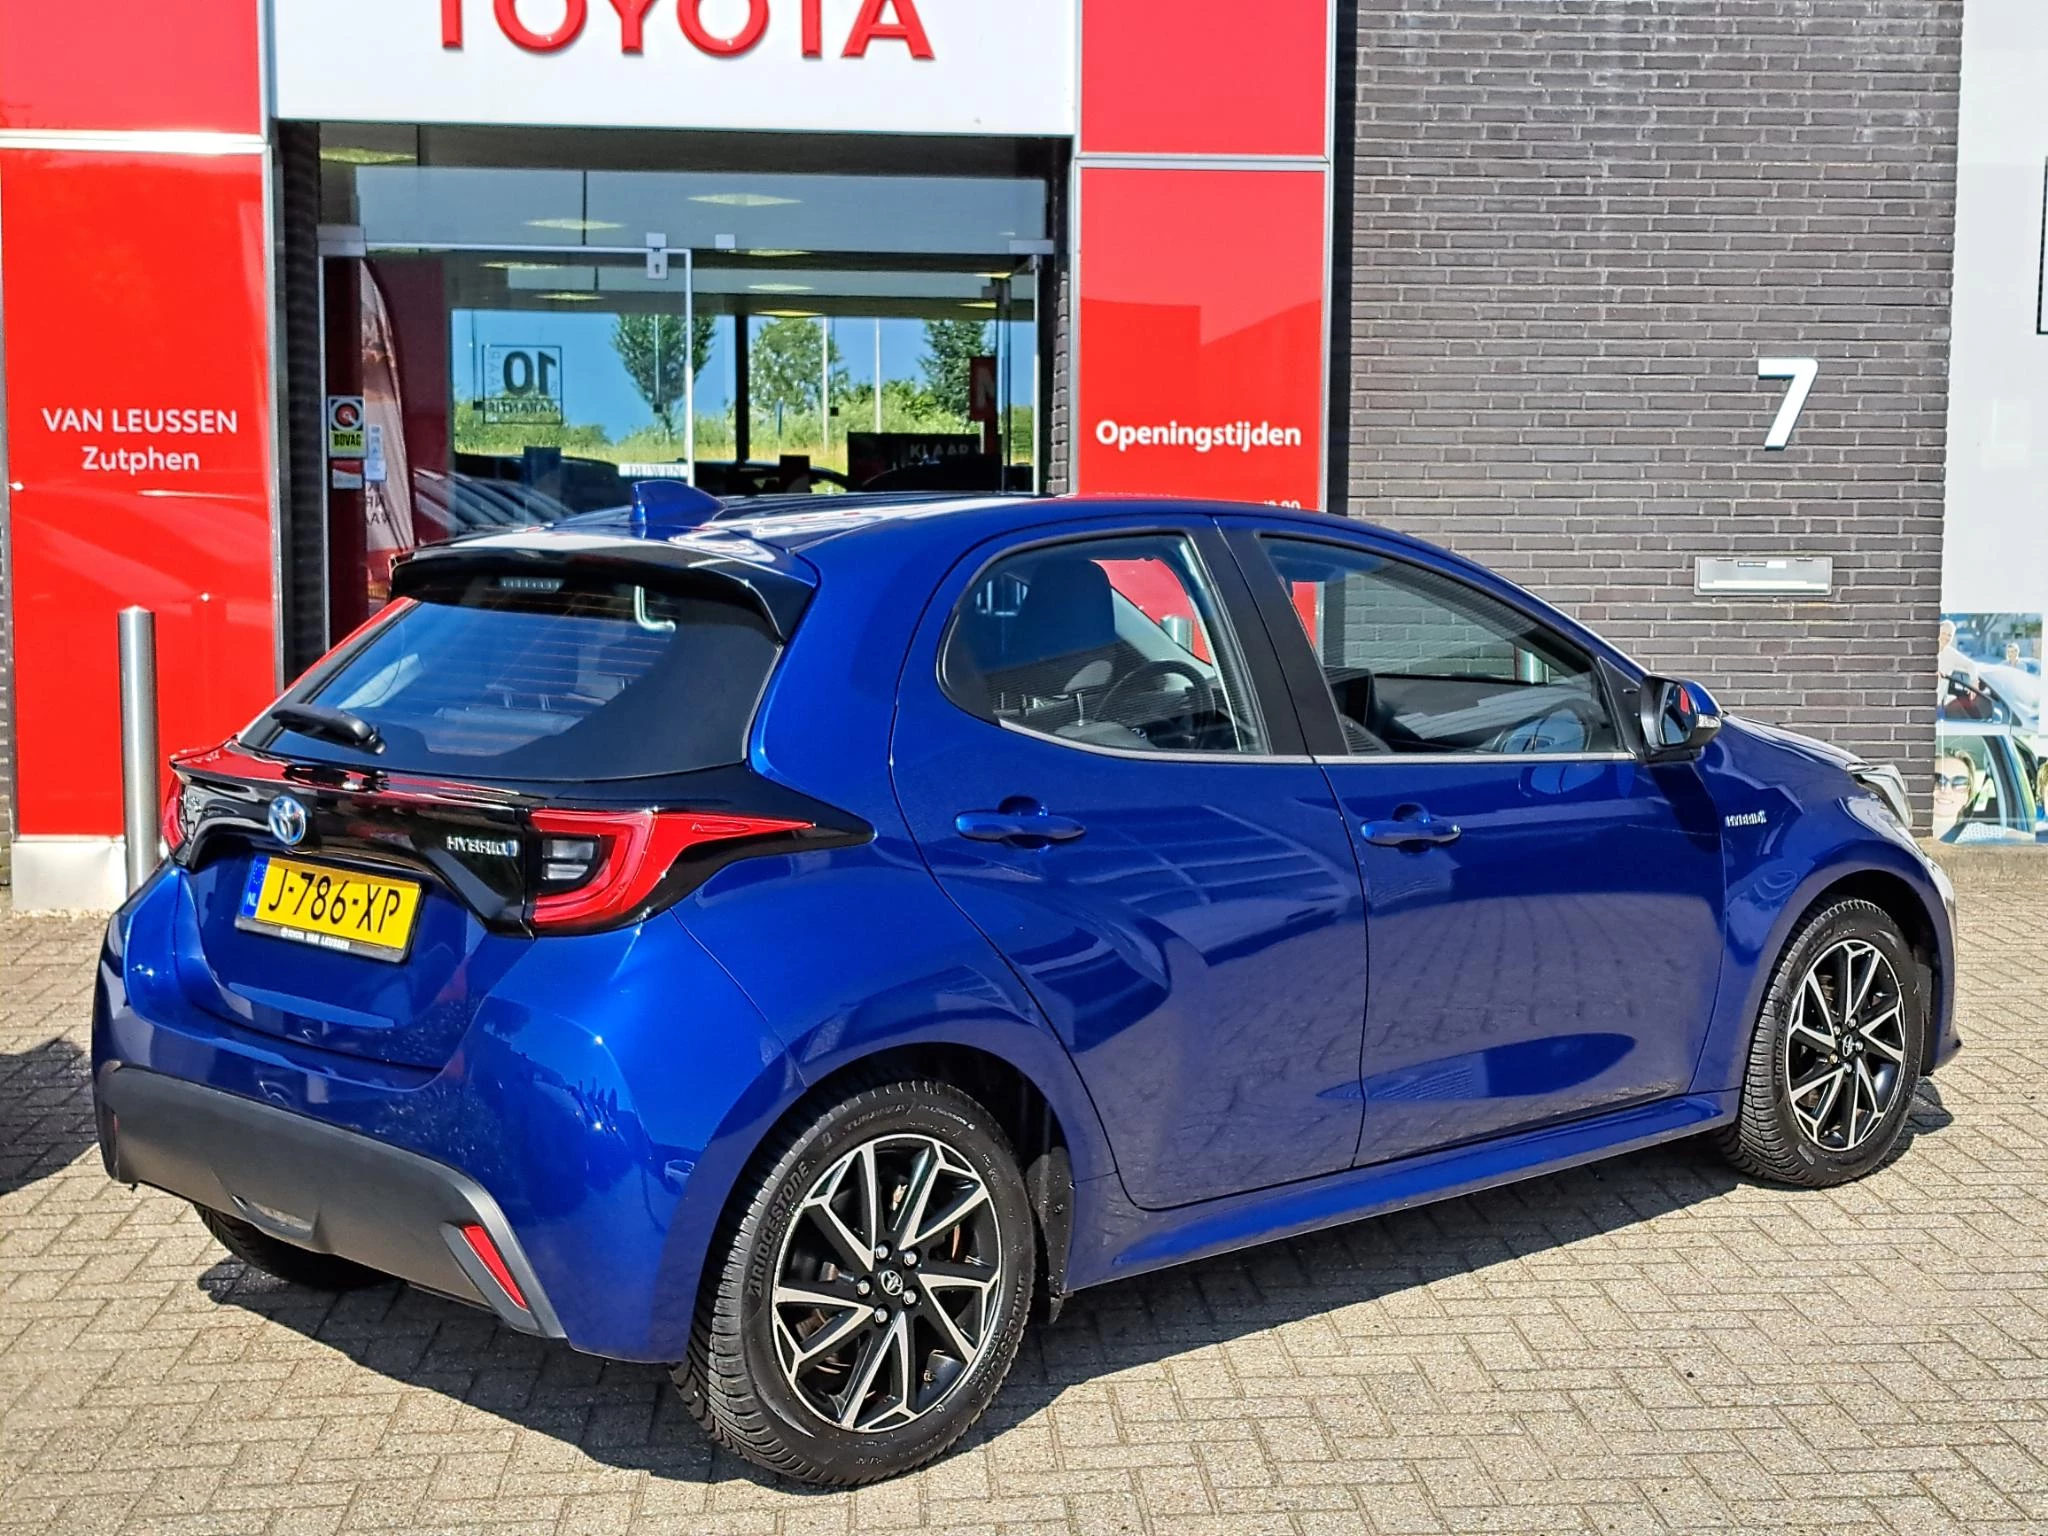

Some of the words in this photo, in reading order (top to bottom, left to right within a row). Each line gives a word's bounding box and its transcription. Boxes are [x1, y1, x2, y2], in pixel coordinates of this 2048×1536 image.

[41, 407, 103, 432] VAN
[112, 408, 238, 434] LEUSSEN
[1758, 358, 1818, 451] 7
[1095, 419, 1302, 452] Openingstijden
[81, 445, 199, 476] Zutphen
[446, 836, 518, 857] HYBRID
[268, 868, 401, 933] J-786-XP
[747, 1160, 811, 1298] BRIDGESTONE
